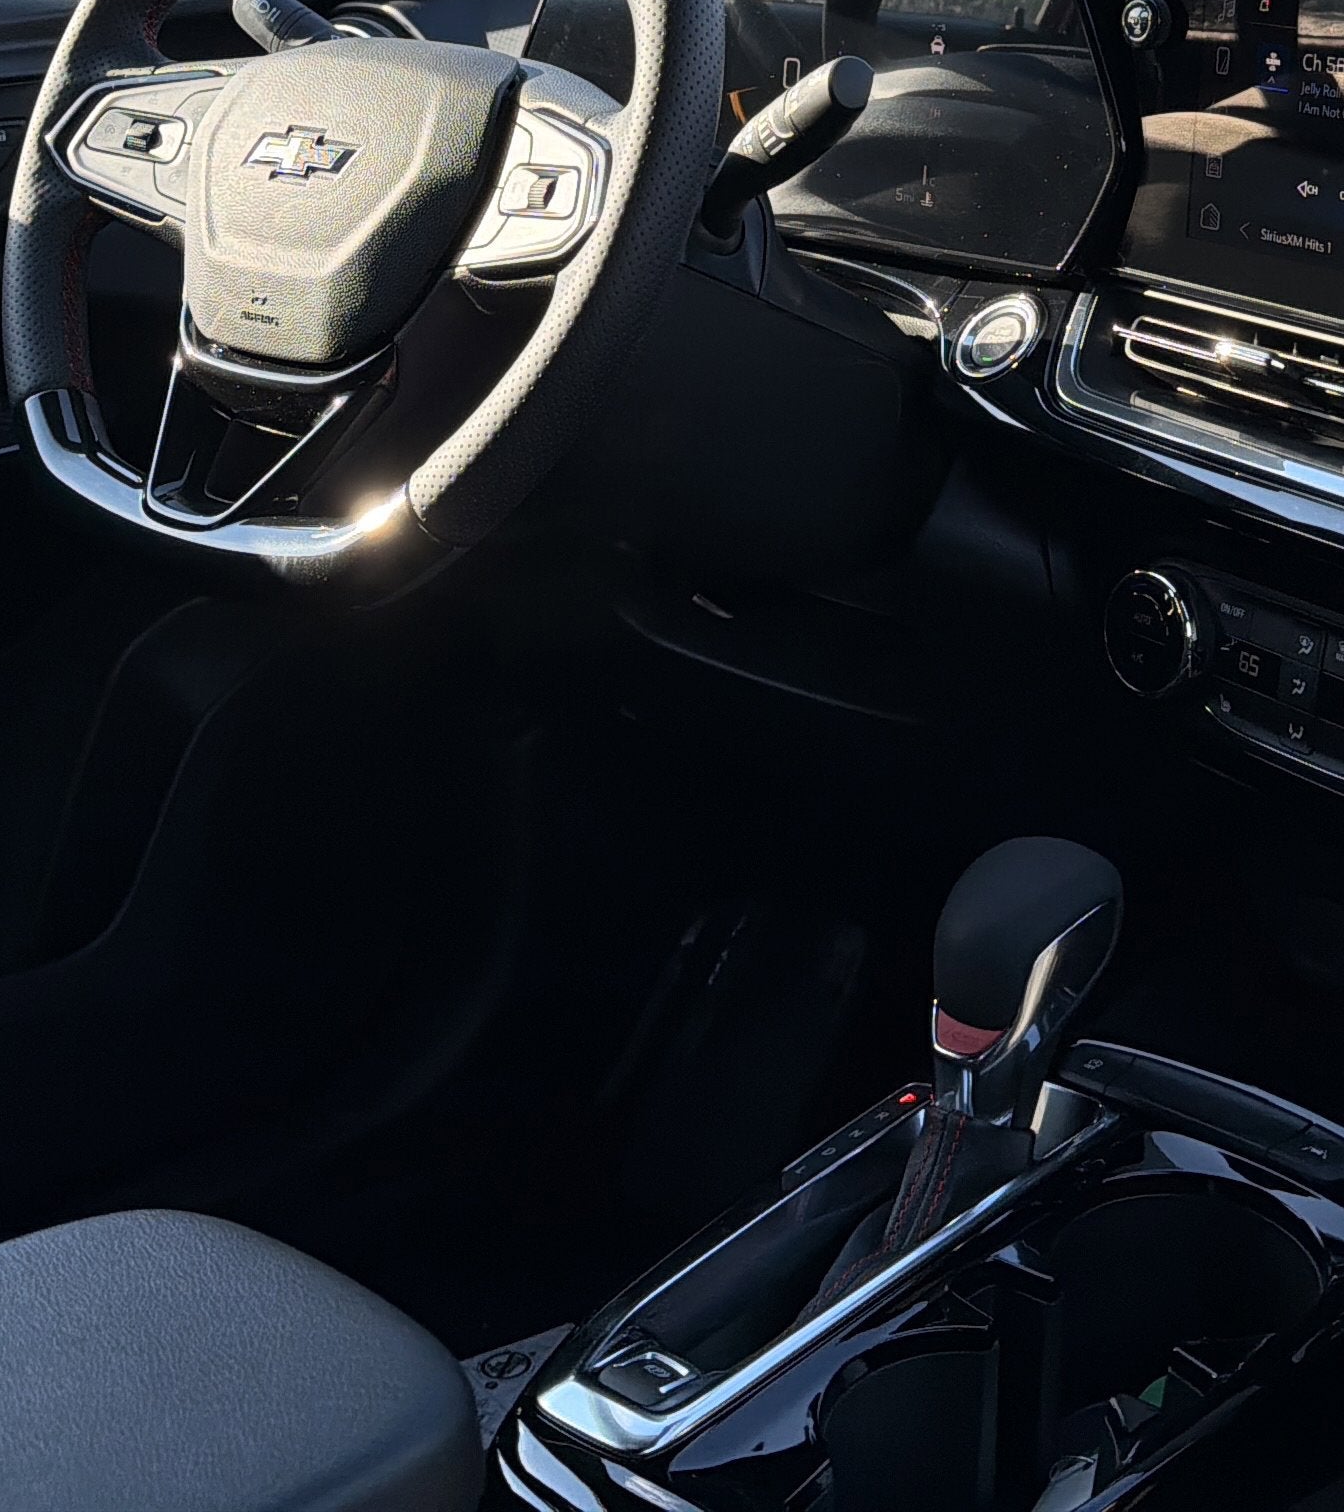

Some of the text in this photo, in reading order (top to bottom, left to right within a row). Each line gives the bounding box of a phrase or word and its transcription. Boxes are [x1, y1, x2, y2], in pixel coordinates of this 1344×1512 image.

[1302, 53, 1322, 72] Ch
[1303, 102, 1320, 116] Am
[1322, 105, 1340, 119] Not
[1260, 228, 1303, 248] SiriusXM
[1305, 236, 1325, 252] Hits
[1220, 602, 1247, 619] ON/OFF
